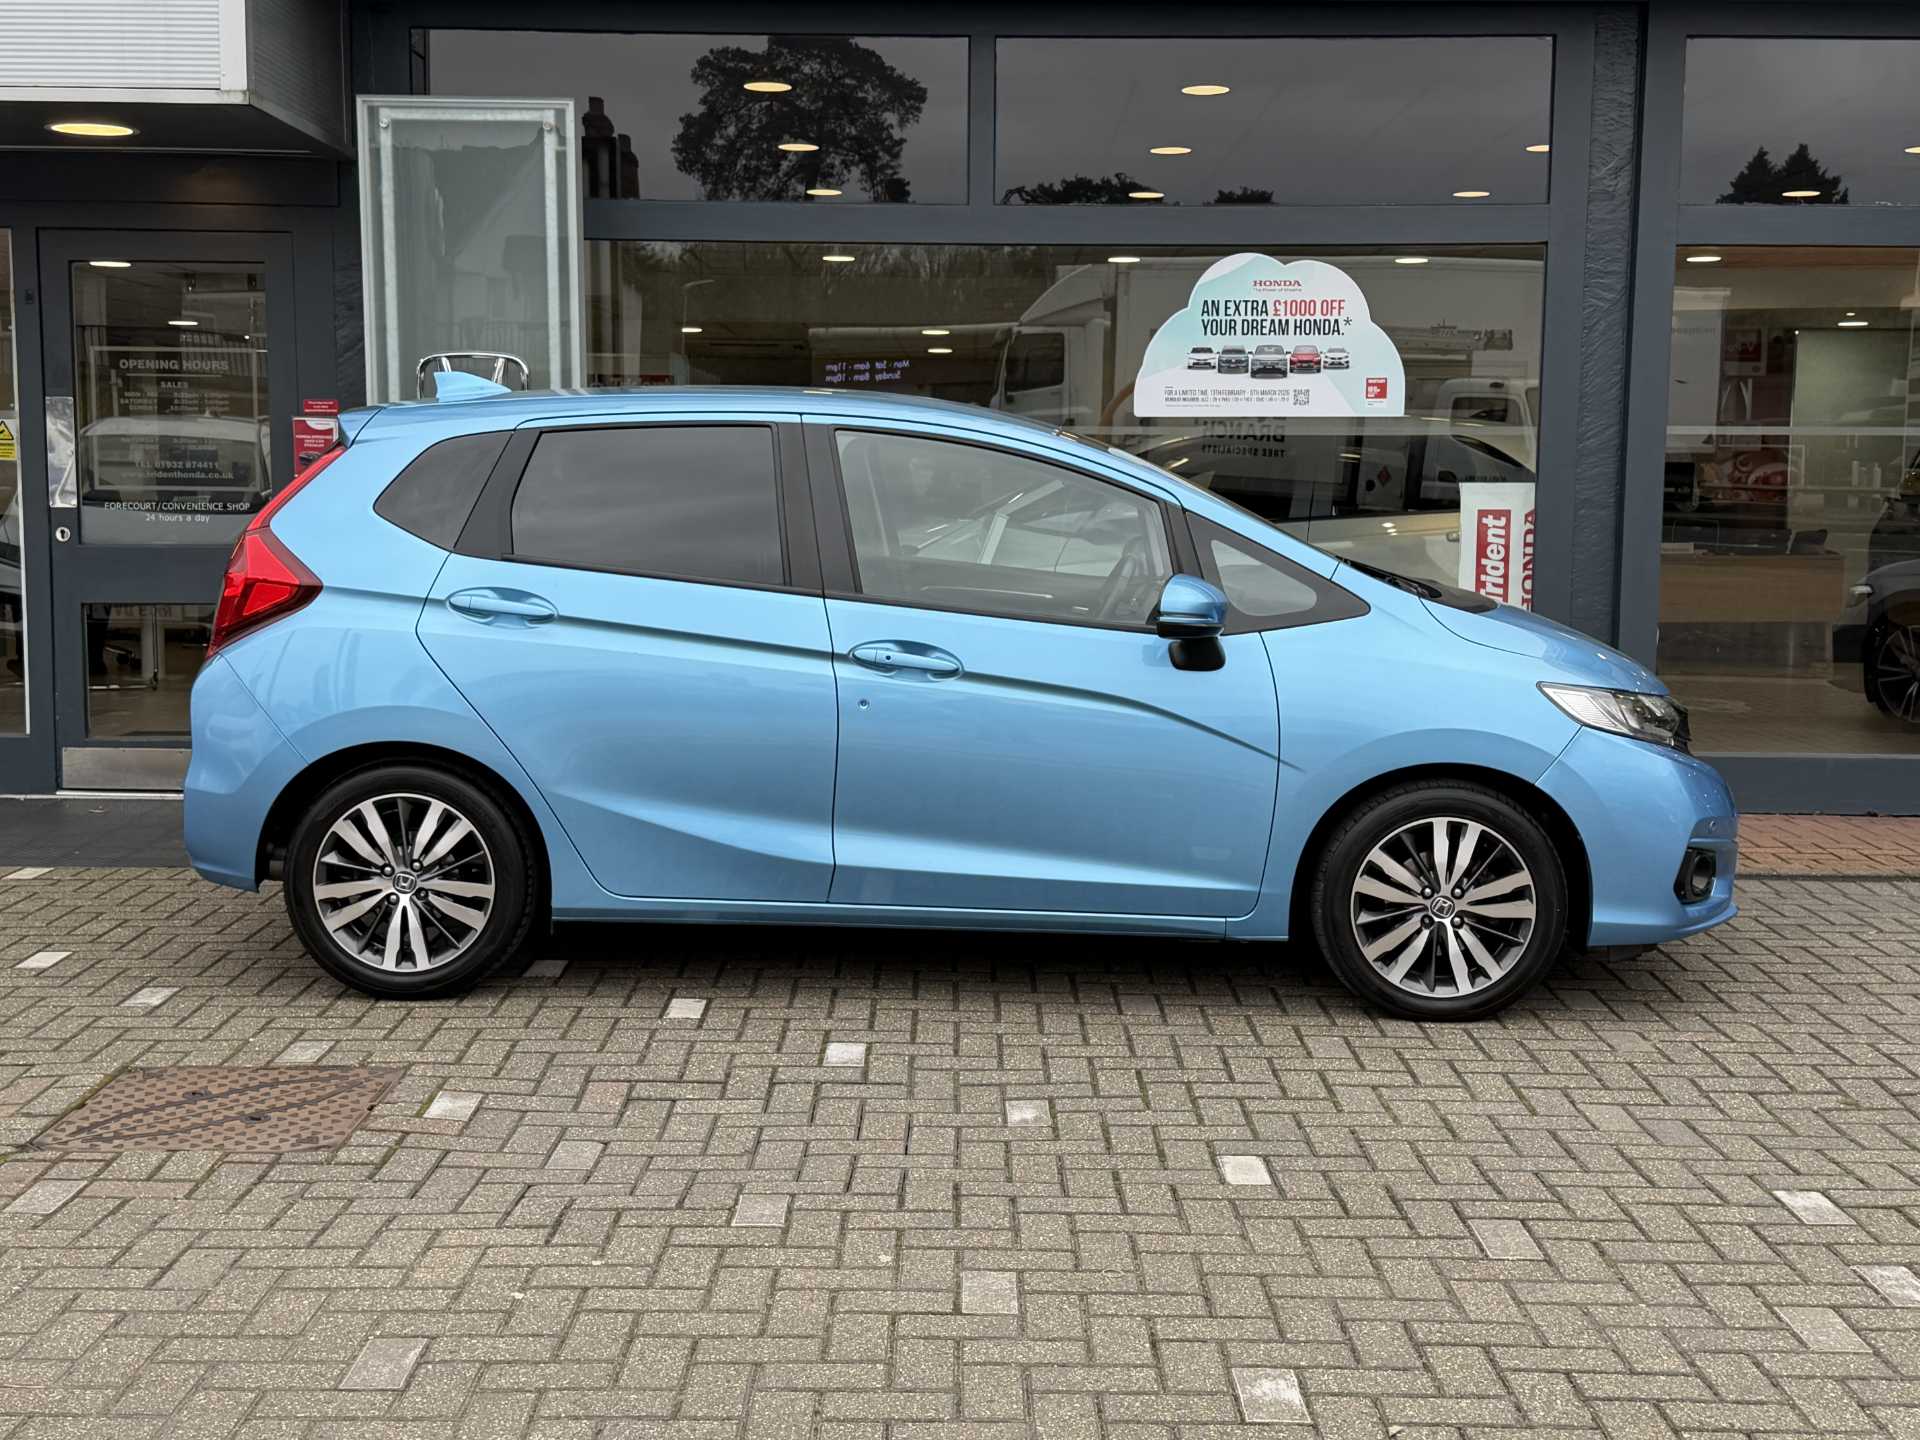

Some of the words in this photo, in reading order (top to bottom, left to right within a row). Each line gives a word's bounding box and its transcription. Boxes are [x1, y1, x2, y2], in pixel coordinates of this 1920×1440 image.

[1201, 300, 1220, 317] AN
[1224, 300, 1268, 317] EXTRA
[1273, 300, 1316, 316] £1000
[1320, 300, 1345, 316] OFF
[1202, 319, 1238, 336] YOUR
[1241, 319, 1290, 336] DREAM
[119, 359, 179, 370] OPENING
[183, 360, 229, 370] HOURS
[160, 381, 188, 389] SALES
[104, 502, 223, 511] FORECOURT/CONVENIENCE
[227, 502, 251, 511] SHOP
[146, 514, 156, 522] 24
[159, 514, 182, 522] hours
[195, 514, 210, 523] day
